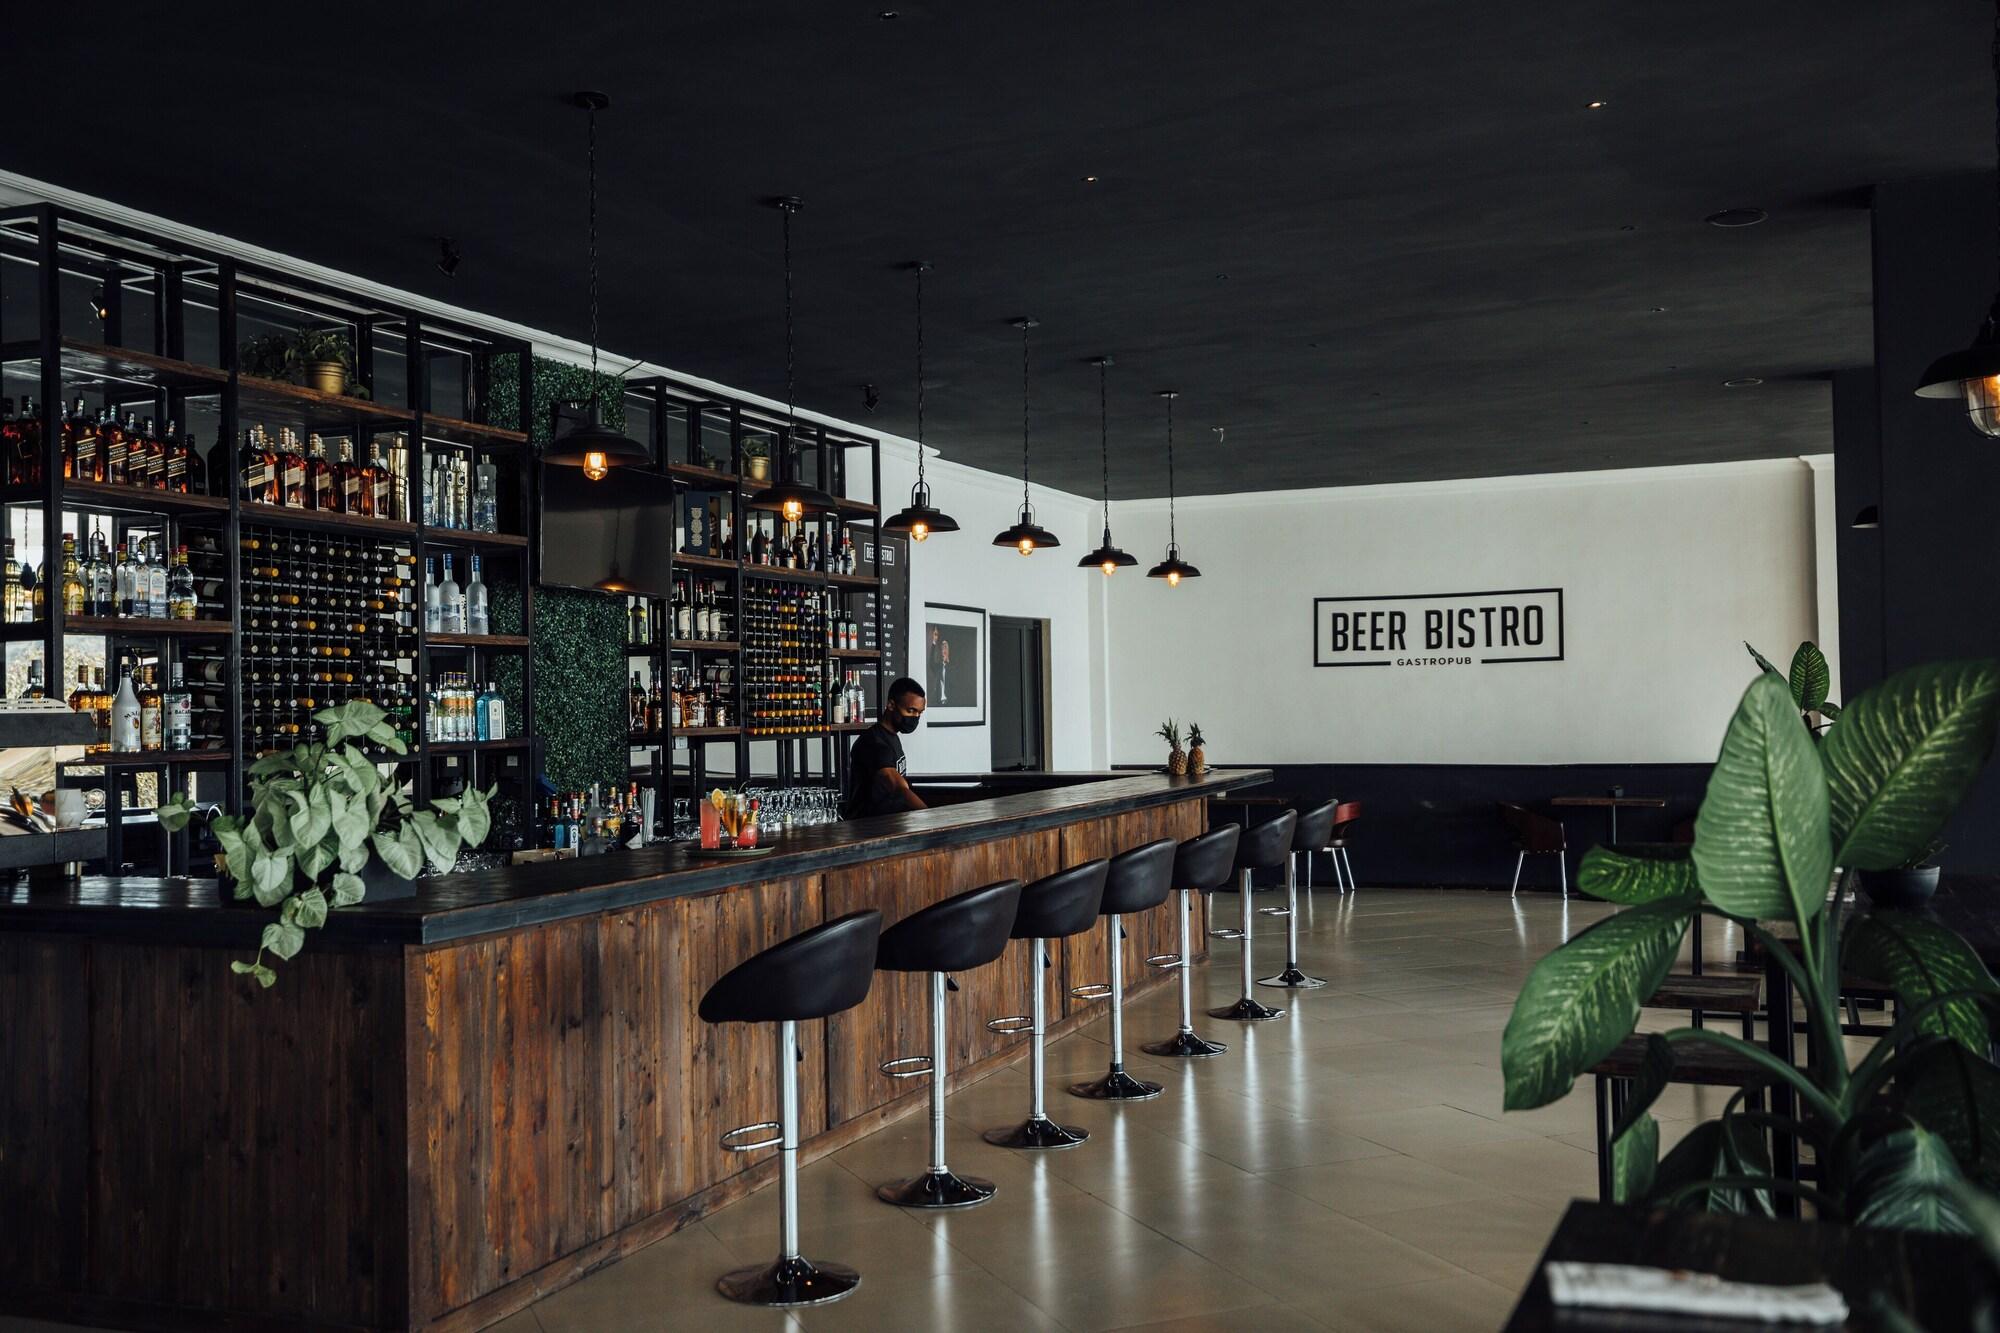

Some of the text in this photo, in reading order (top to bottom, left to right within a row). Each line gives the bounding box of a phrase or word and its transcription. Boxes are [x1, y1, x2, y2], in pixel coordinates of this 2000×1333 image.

[1331, 605, 1544, 652] BEER BISTRO
[1396, 656, 1472, 666] GASTROPUB
